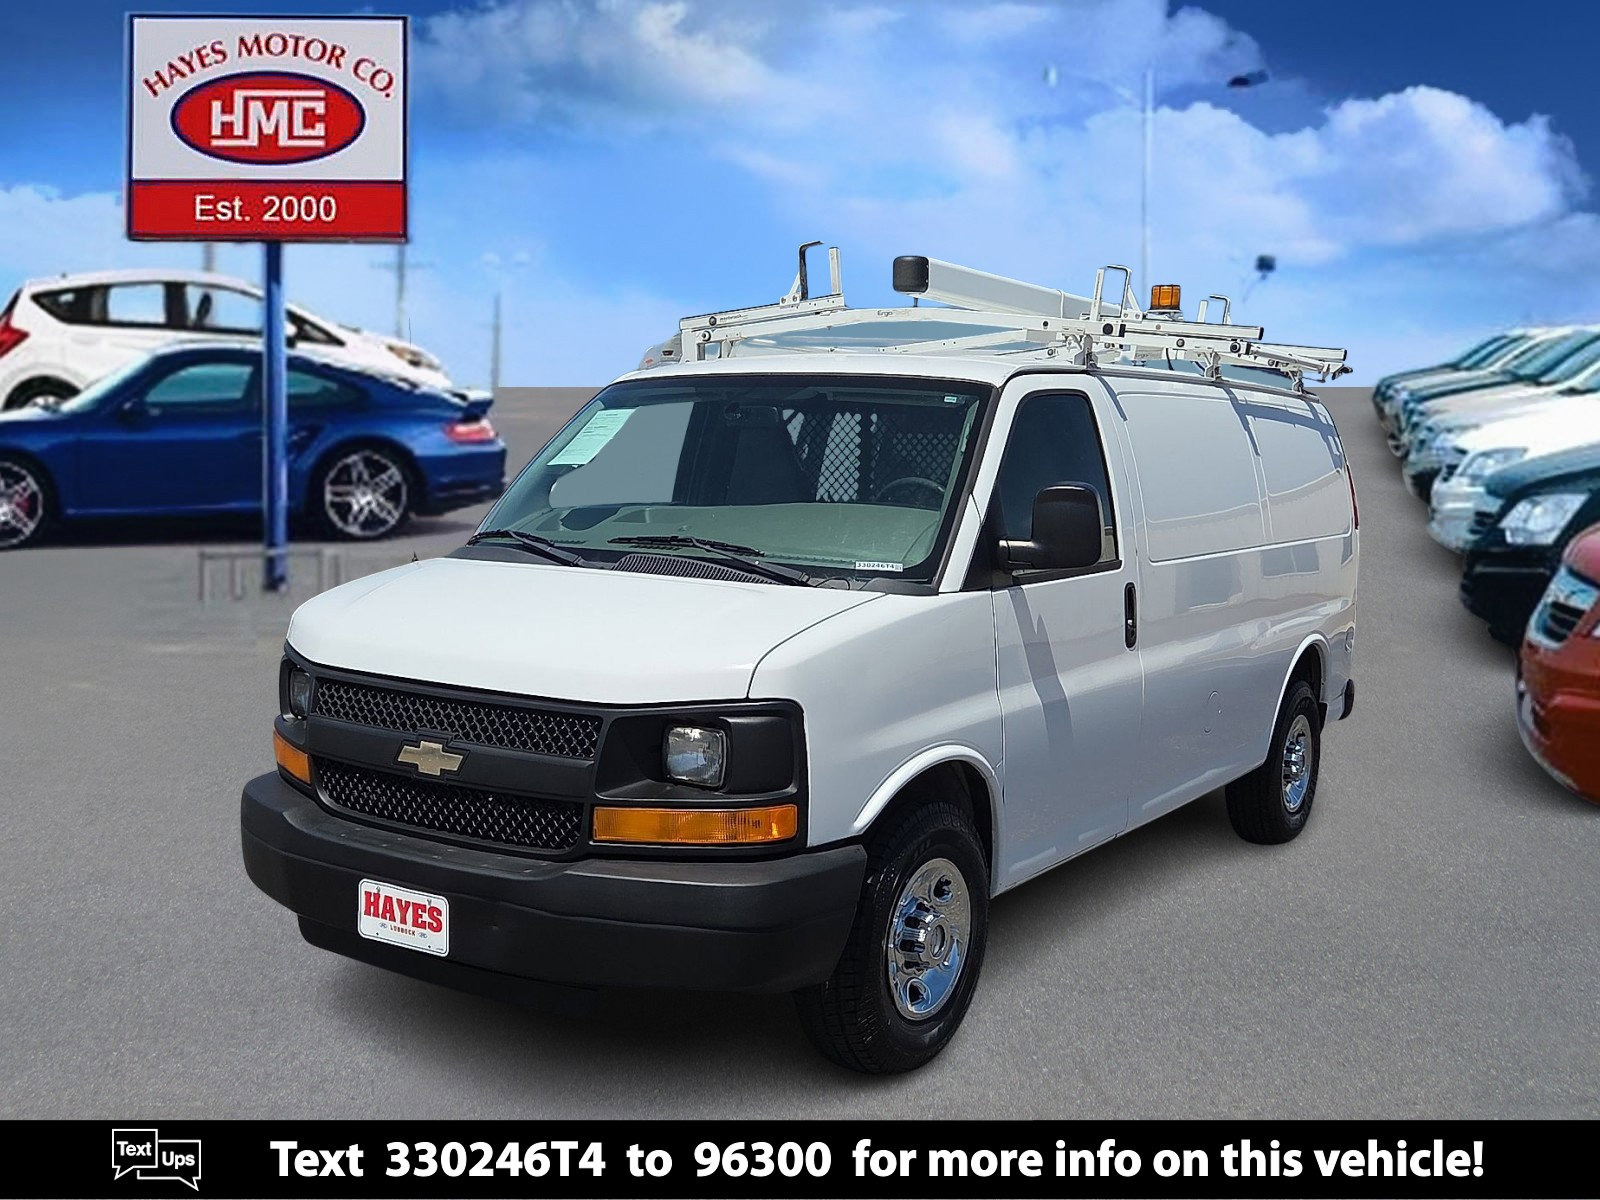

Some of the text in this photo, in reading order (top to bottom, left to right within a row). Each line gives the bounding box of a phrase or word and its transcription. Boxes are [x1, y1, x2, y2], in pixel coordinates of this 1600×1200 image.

[143, 32, 395, 99] HAYES MOTOR CO.
[210, 88, 326, 148] HMC
[194, 193, 338, 223] Est. 2000
[363, 890, 443, 933] HAYES
